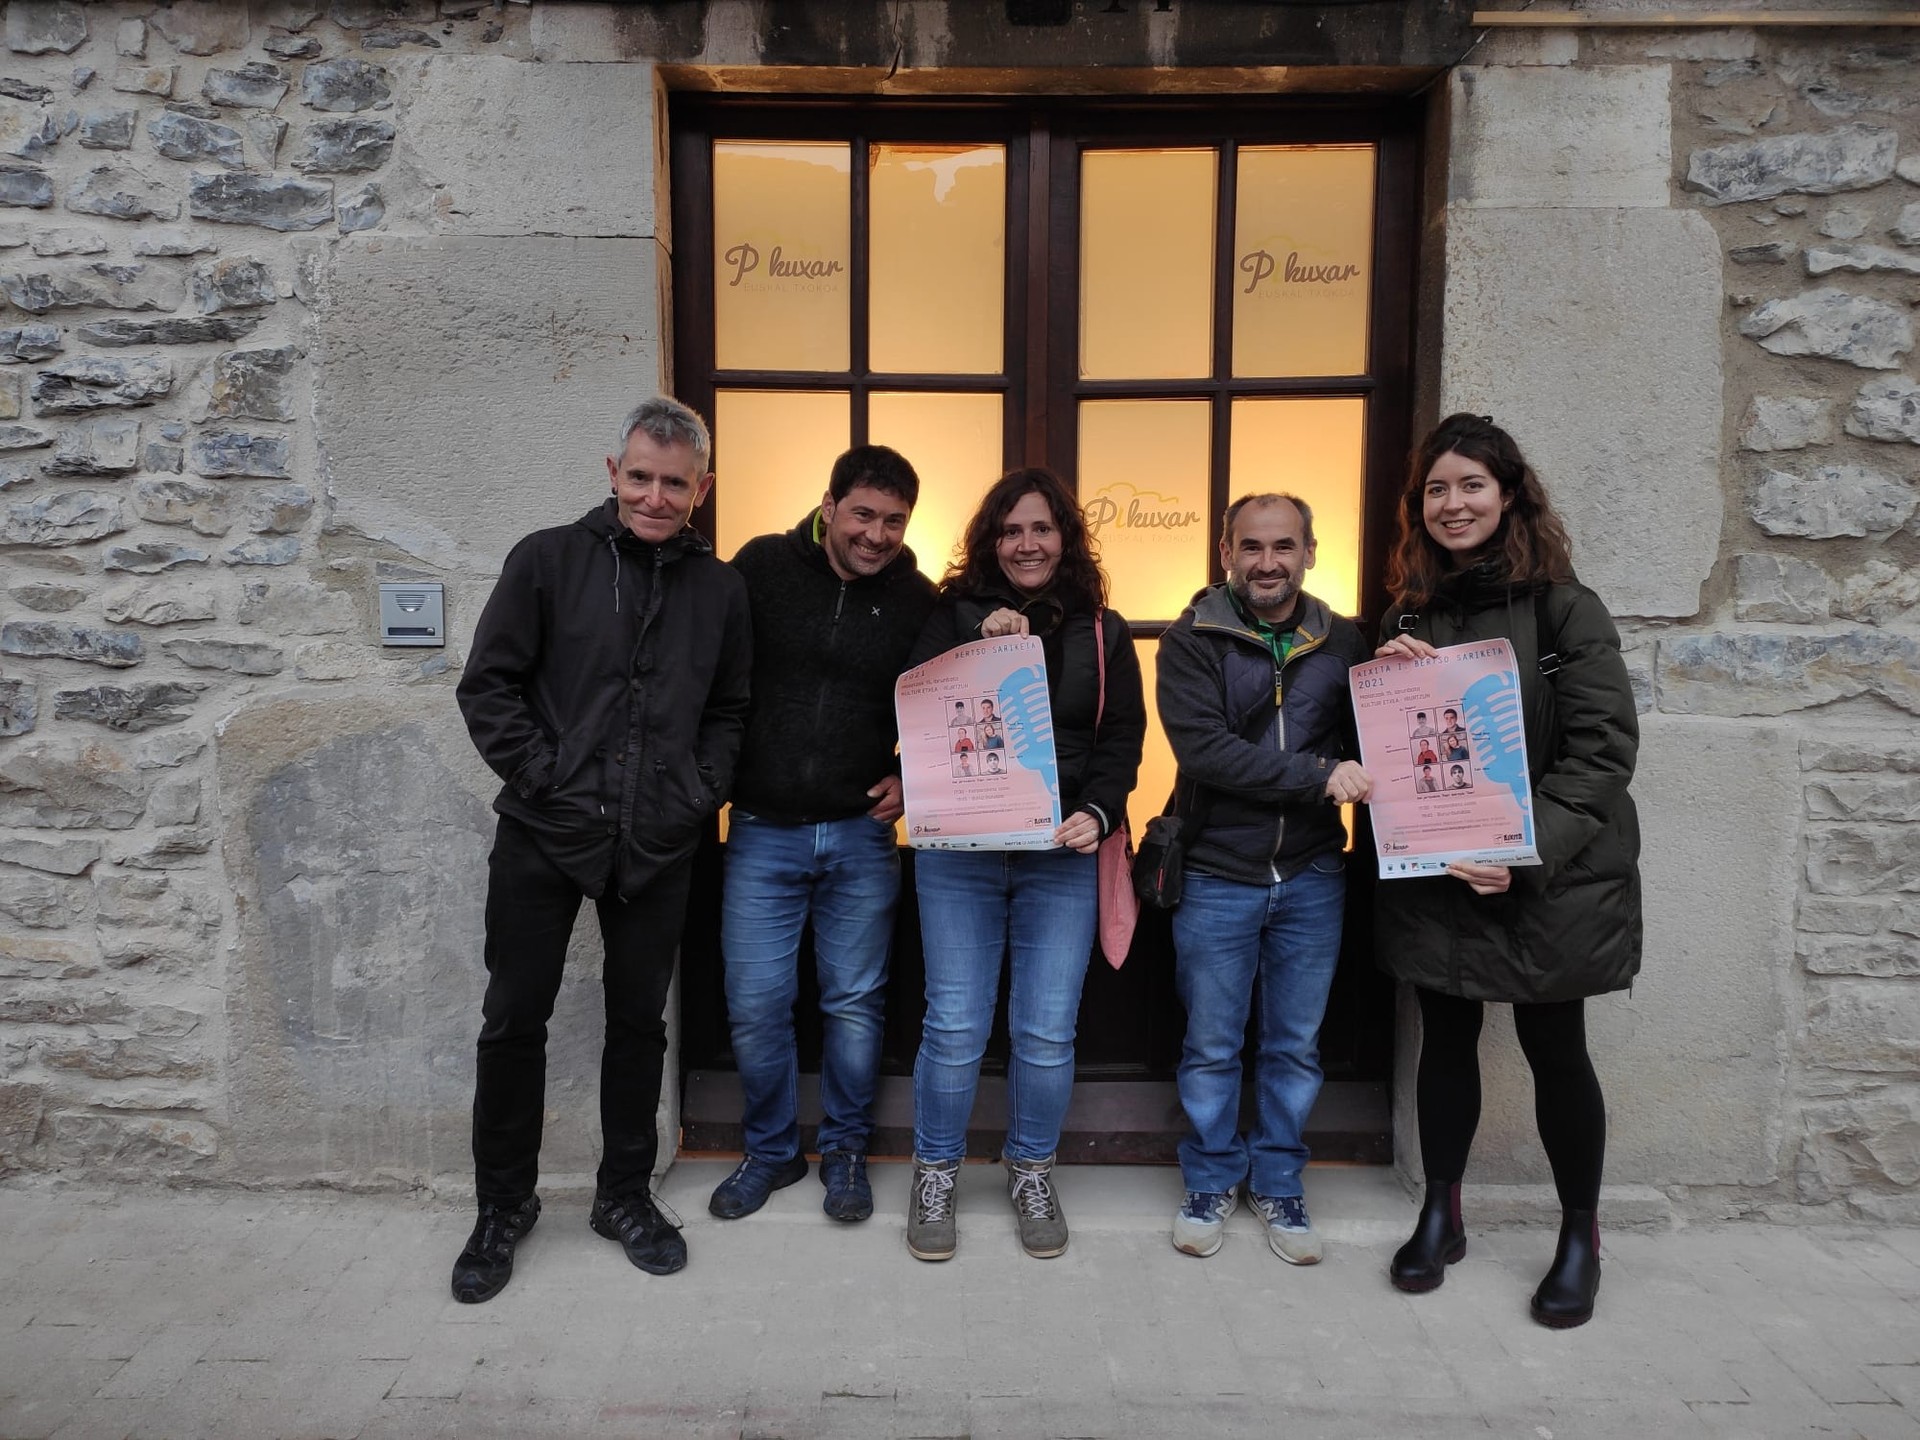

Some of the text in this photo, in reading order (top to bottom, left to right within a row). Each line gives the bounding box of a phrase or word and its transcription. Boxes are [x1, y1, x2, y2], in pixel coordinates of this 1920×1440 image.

[954, 647, 987, 660] BERTSO
[992, 643, 1036, 655] SARIKETA
[1356, 664, 1392, 679] AIXITA
[1413, 655, 1450, 668] BERTSO
[1456, 646, 1504, 663] SARIKETA
[903, 670, 926, 682] 2021
[1358, 677, 1385, 690] 2021
